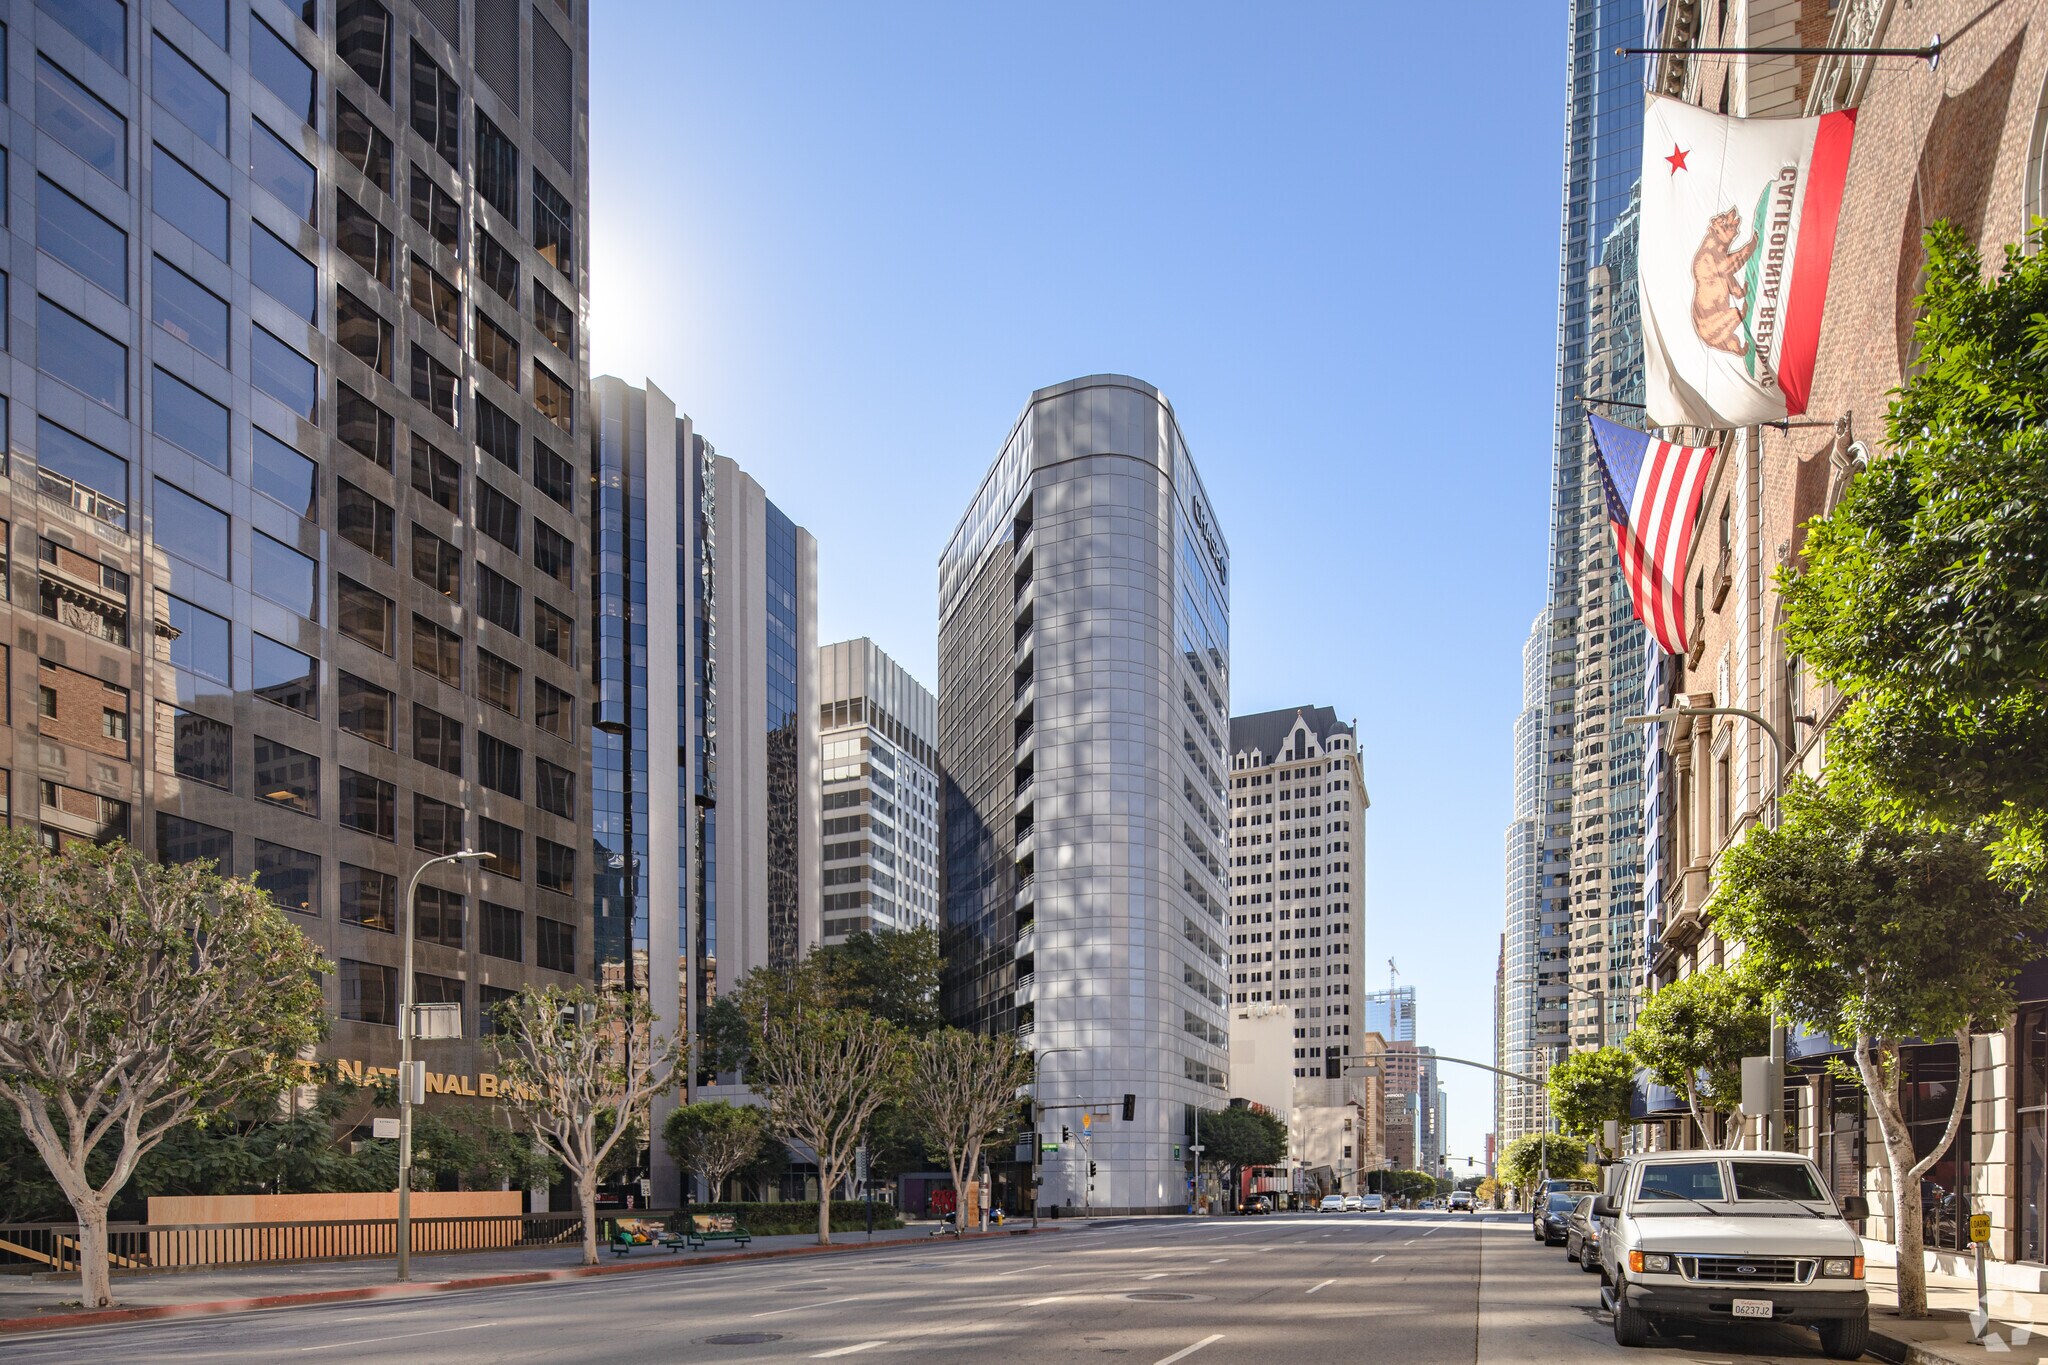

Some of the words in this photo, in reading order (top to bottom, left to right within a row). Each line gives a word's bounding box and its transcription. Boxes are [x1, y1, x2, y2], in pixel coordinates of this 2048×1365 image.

[1193, 495, 1220, 571] CHASE
[337, 1058, 476, 1096] NATNAL
[1970, 1220, 1990, 1228] LOADING
[1975, 1229, 1986, 1237] ONLY
[1735, 1305, 1770, 1316] 06237J2
